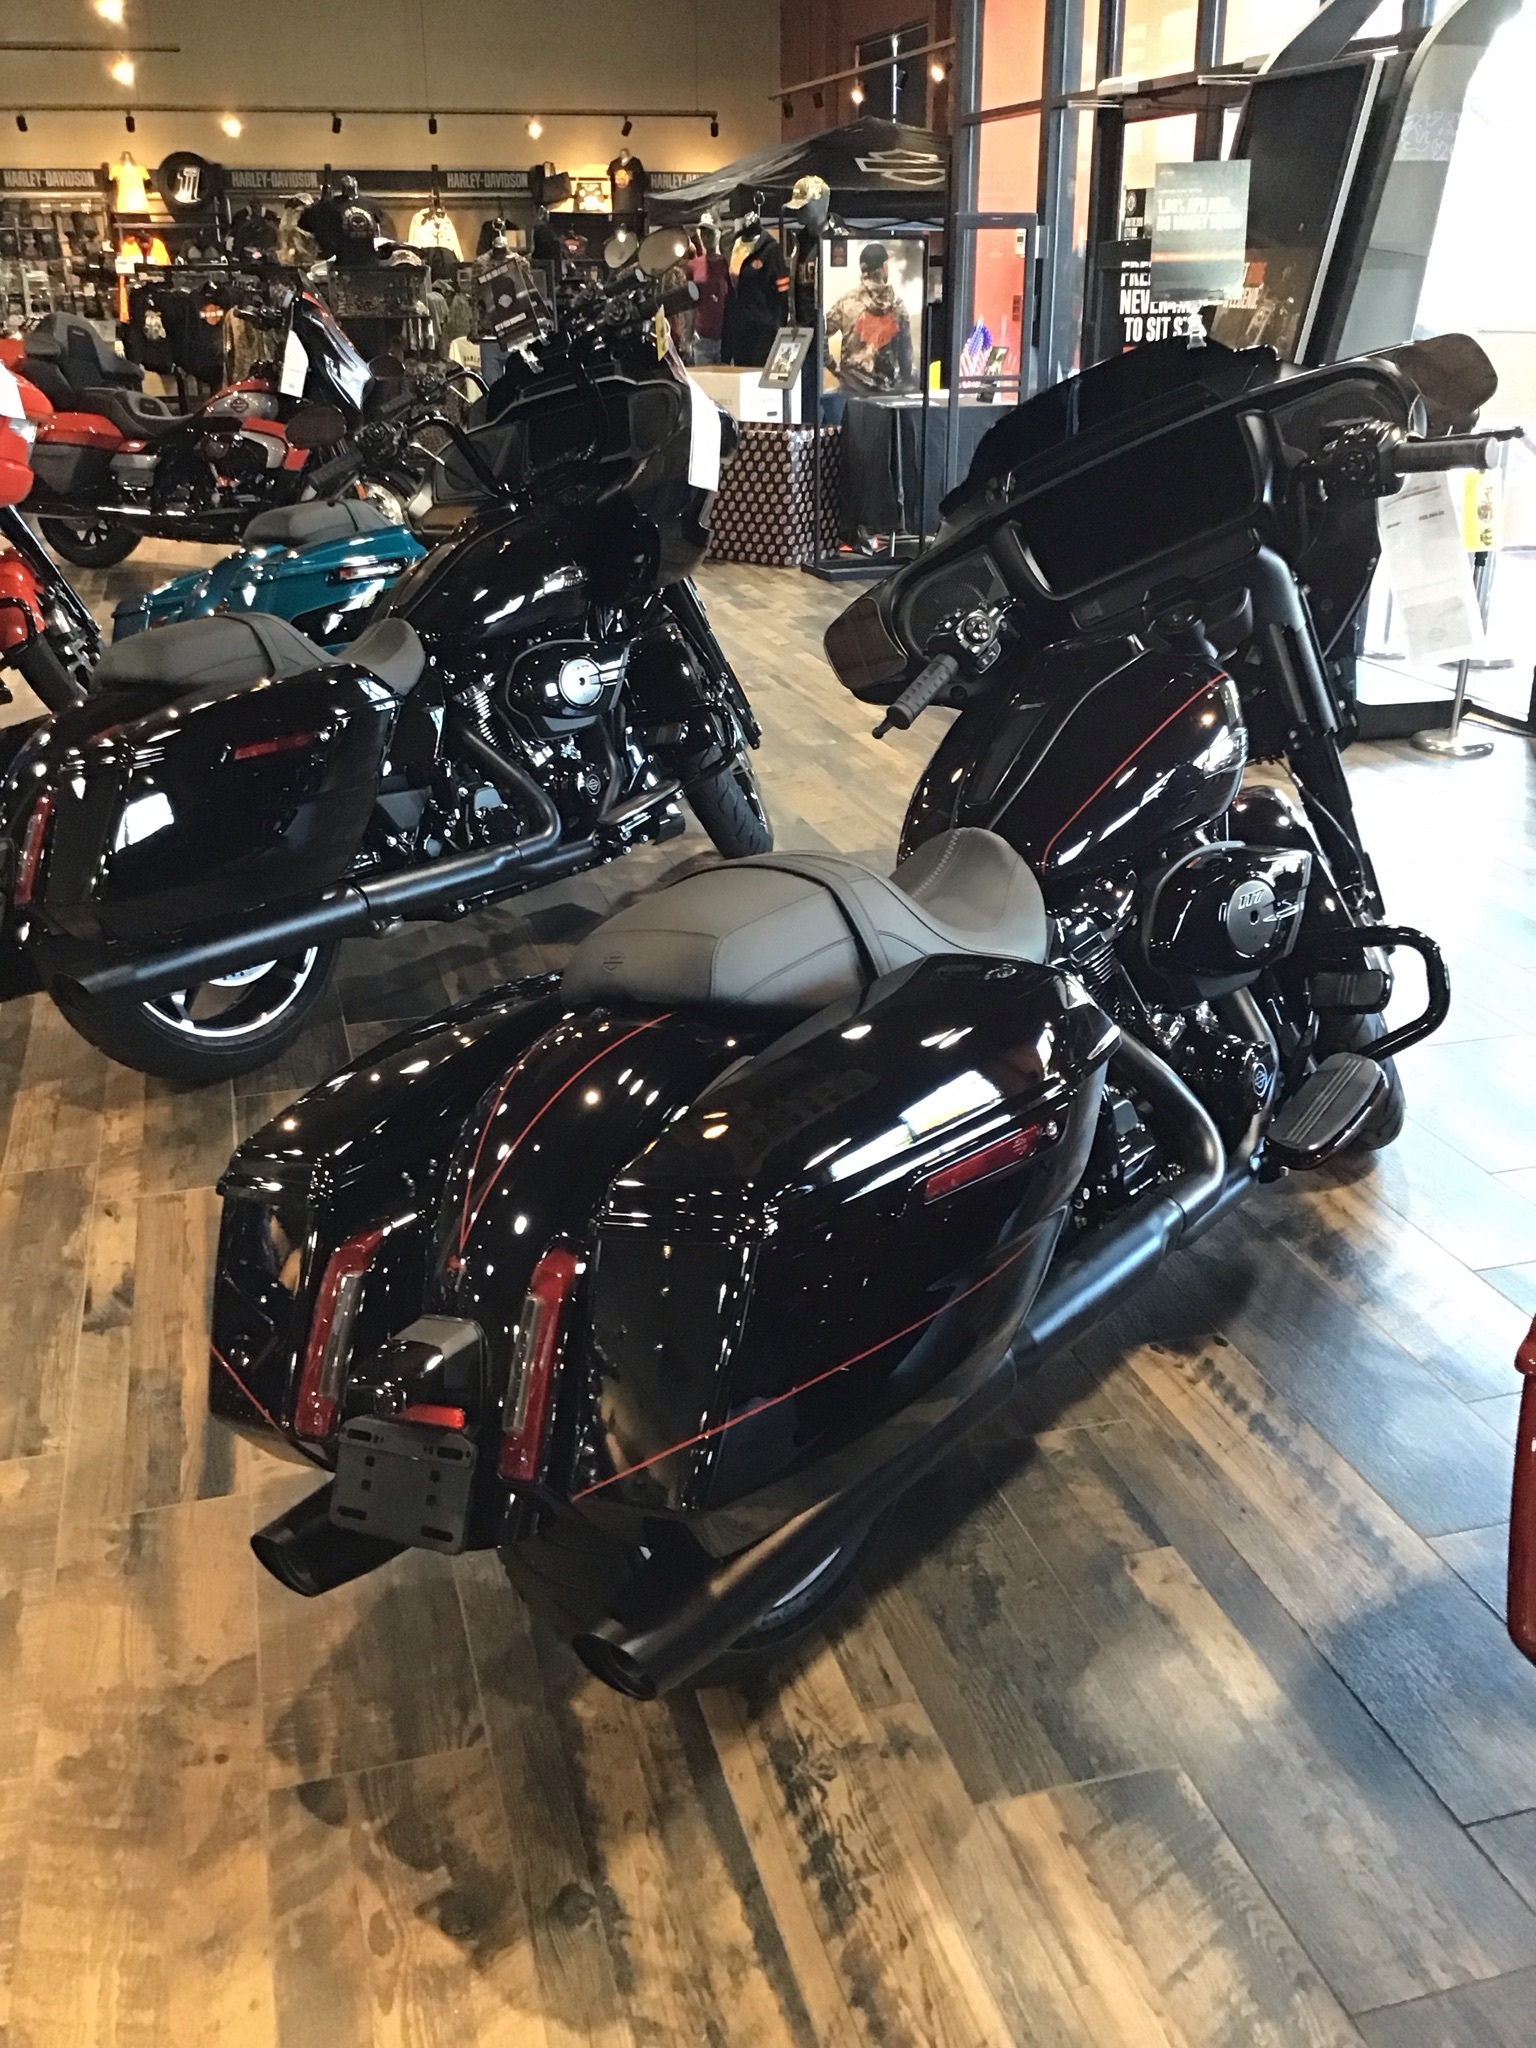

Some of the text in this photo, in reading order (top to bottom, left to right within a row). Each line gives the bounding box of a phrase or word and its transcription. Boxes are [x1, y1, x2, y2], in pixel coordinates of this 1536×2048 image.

[3, 170, 95, 187] HARLEY-DAVIDSON
[231, 172, 318, 188] HARLEY-DAVIDSON
[446, 172, 528, 189] HARLEY-DAVIDSON
[1123, 316, 1143, 343] TO
[1145, 316, 1171, 342] SIT
[1237, 888, 1265, 910] 117
